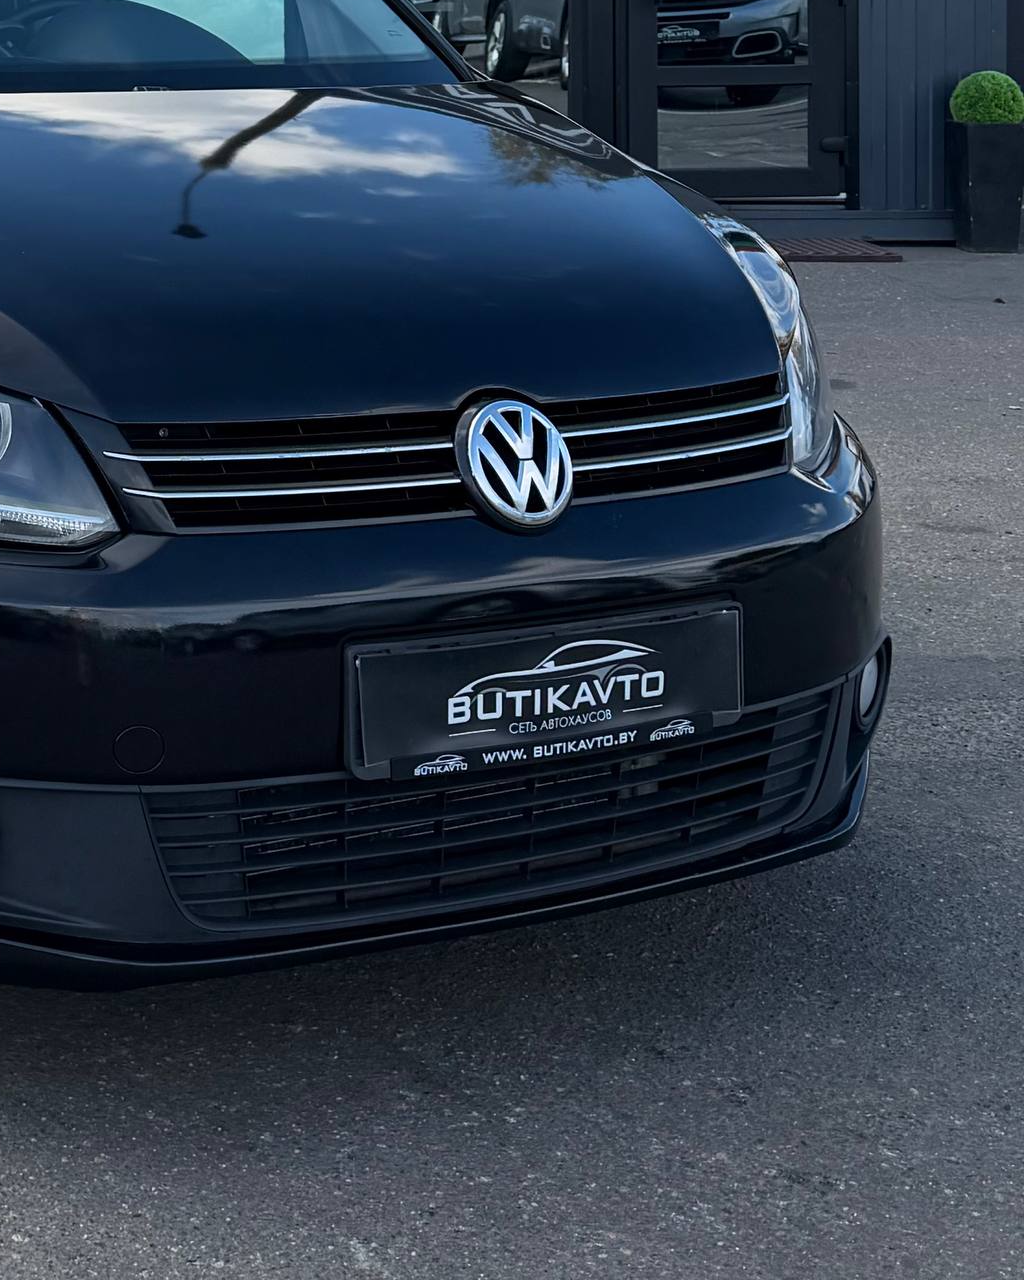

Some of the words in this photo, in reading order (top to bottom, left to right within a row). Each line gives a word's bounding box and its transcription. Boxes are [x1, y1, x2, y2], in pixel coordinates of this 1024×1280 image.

[447, 670, 665, 725] BUTIKAVTO
[508, 720, 538, 735] СЕТЬ
[539, 708, 613, 731] АВТОХАУСОВ
[650, 726, 695, 742] BUTIKAVTO
[482, 748, 528, 765] WWW.
[533, 730, 638, 758] BUTIKAVTO.BY
[413, 762, 468, 777] BUTIKAVTO
